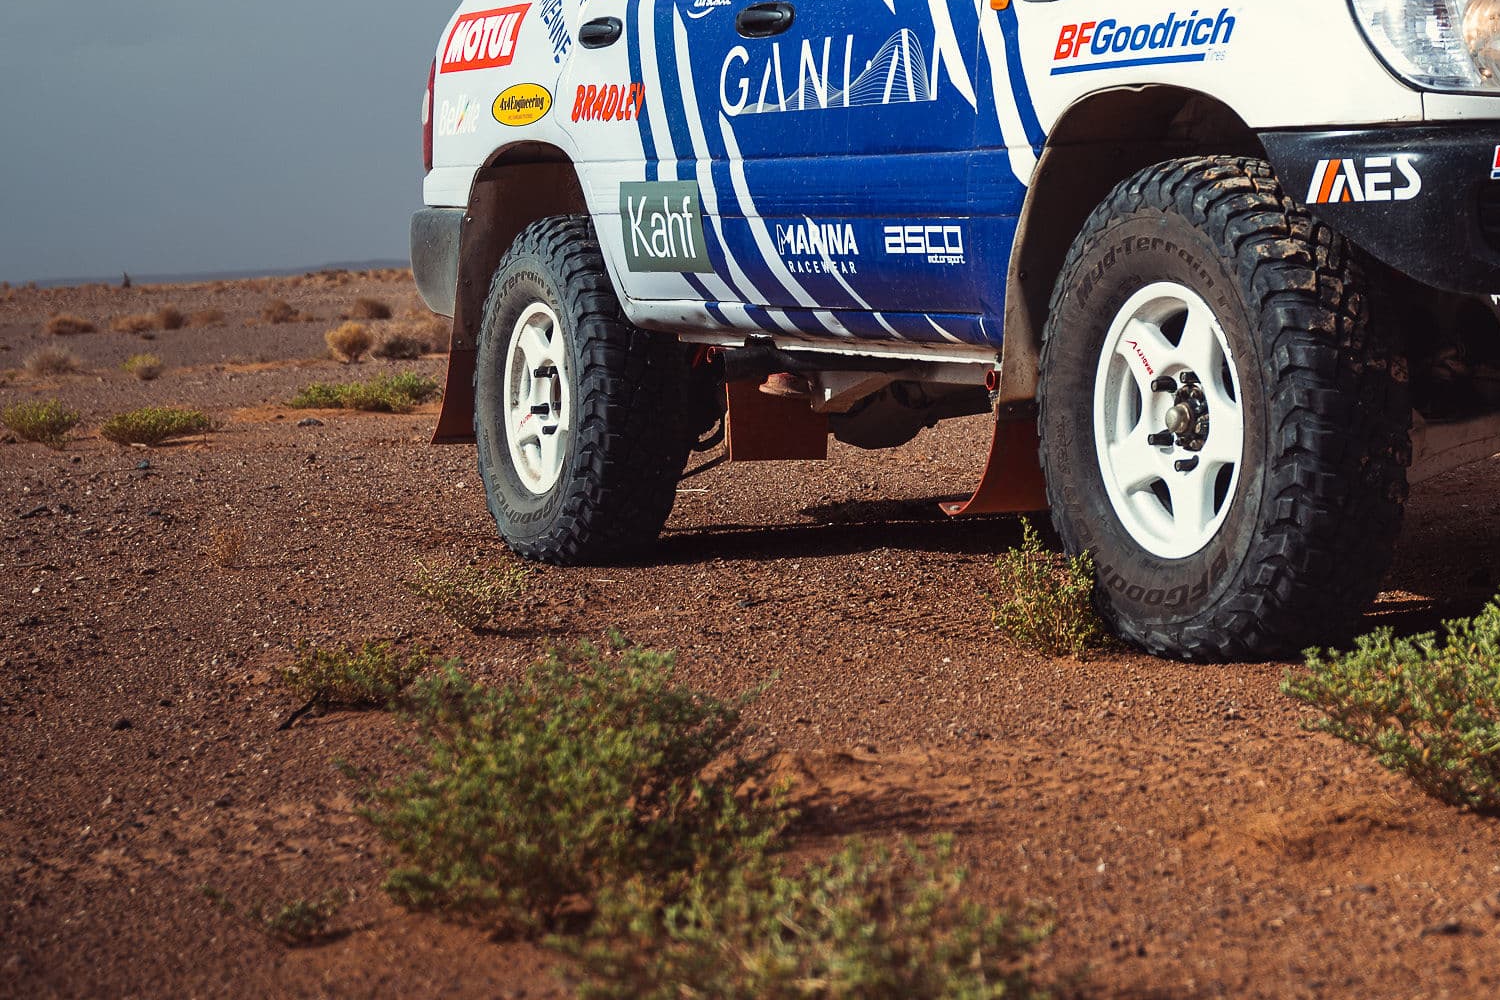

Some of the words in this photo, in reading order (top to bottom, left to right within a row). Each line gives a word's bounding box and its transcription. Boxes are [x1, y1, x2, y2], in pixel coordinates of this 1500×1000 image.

[443, 11, 522, 64] MOTUL
[1053, 8, 1236, 61] BFGoodrich
[571, 83, 645, 123] BRADLEY
[627, 195, 697, 259] Kahf
[777, 223, 860, 255] MARINA
[789, 260, 858, 275] RACEWEAR
